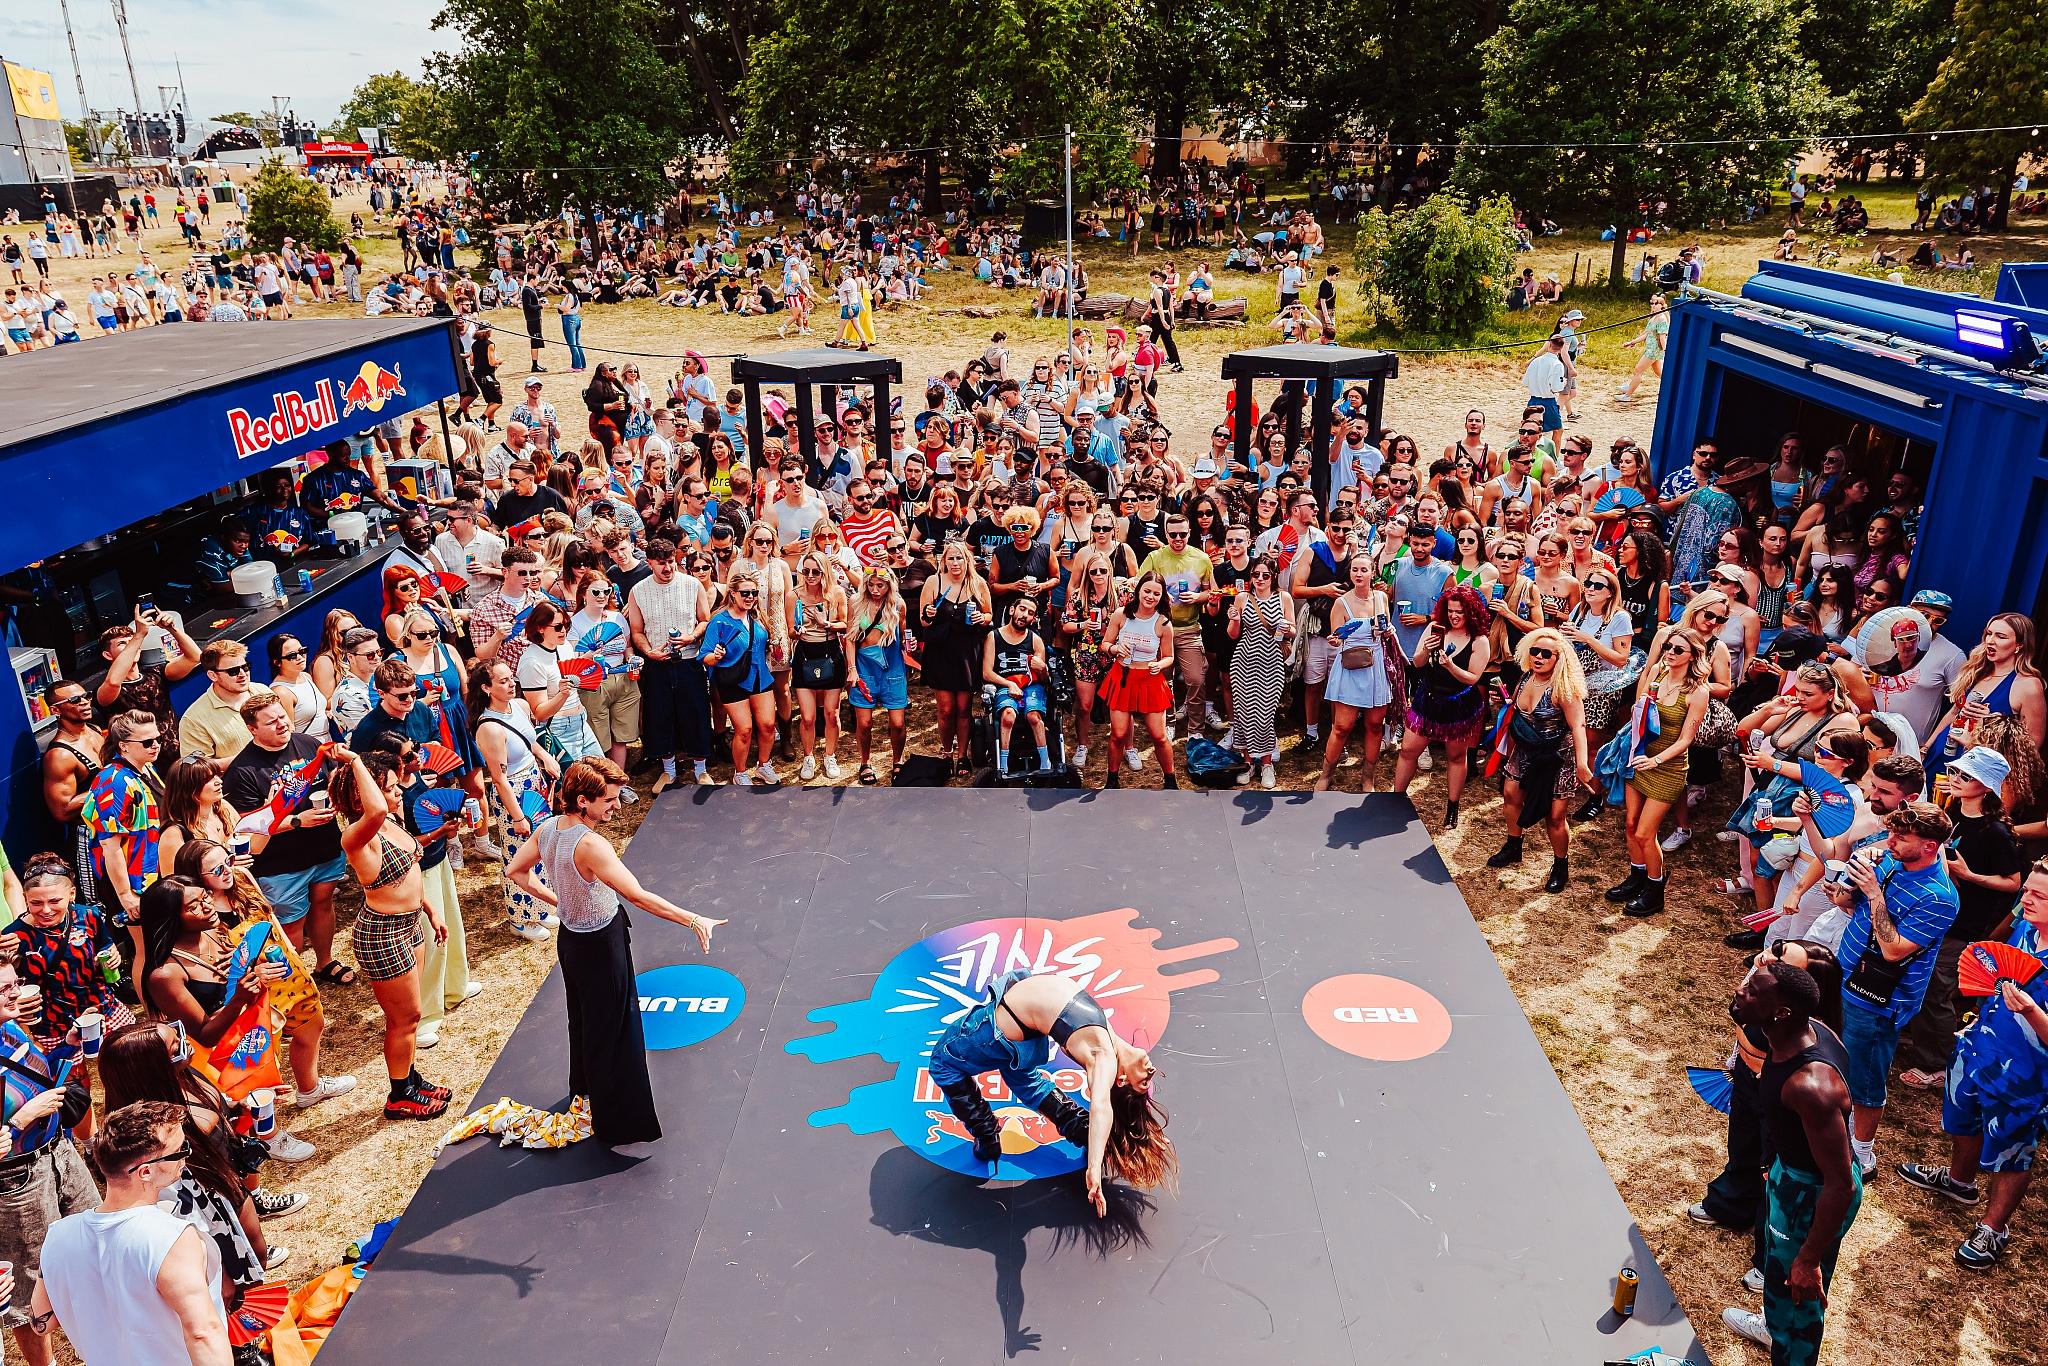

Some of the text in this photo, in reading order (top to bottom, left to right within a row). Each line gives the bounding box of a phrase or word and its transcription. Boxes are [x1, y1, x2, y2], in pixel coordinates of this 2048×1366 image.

[712, 477, 730, 487] bra
[1849, 981, 1887, 1003] VALENTINO
[1333, 1007, 1419, 1023] RED
